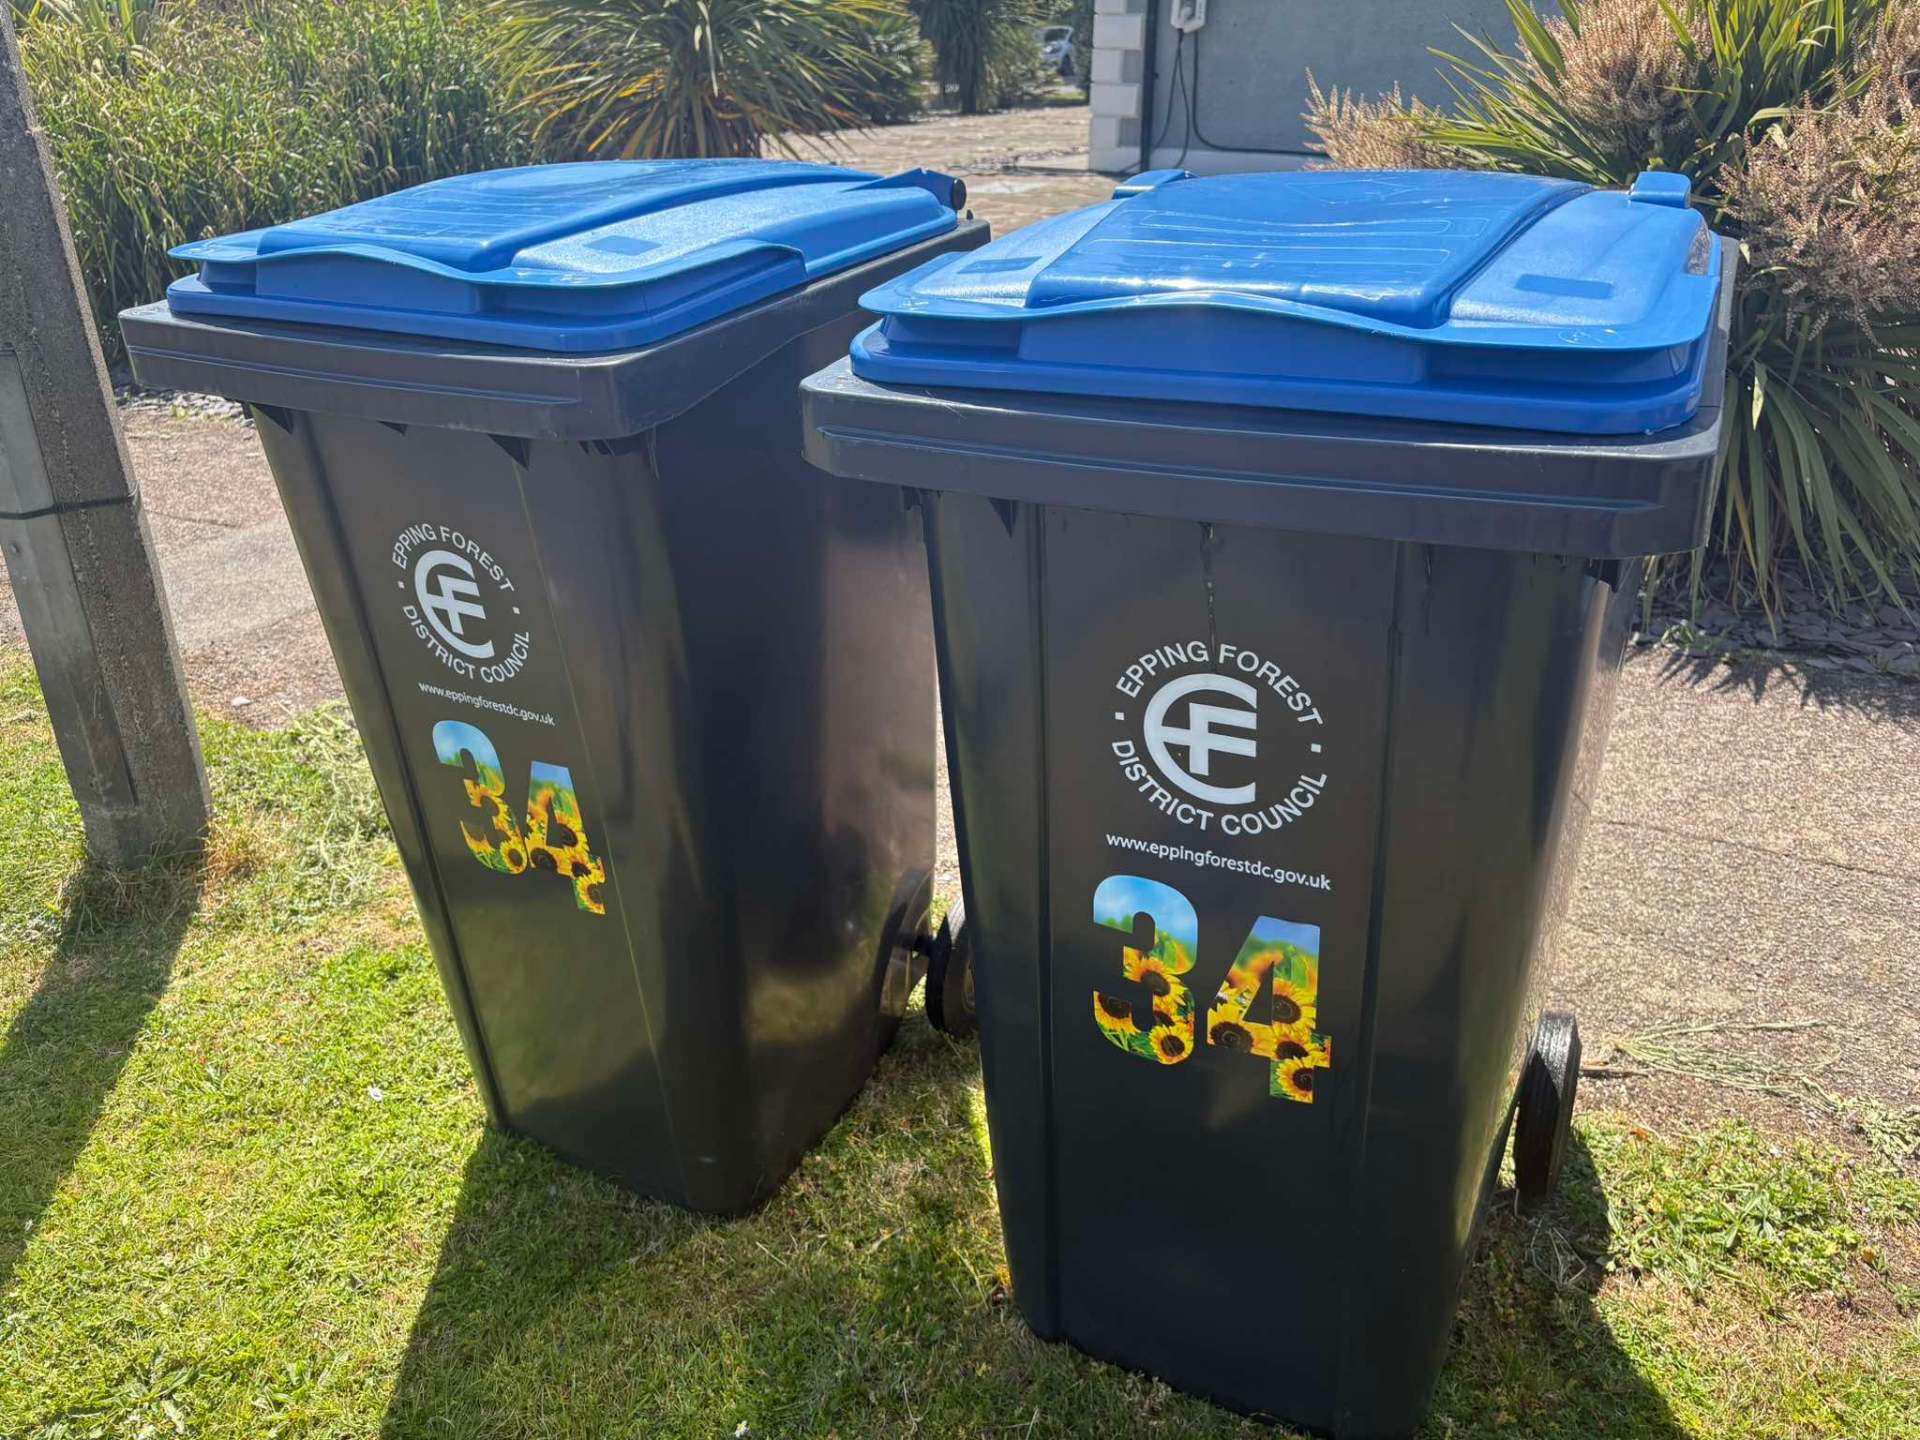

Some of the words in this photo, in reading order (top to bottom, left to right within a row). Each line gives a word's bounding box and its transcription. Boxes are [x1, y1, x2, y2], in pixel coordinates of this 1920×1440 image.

[392, 523, 437, 570] EPPING
[439, 525, 515, 592] FOREST
[402, 604, 476, 680] DISTRICT
[480, 631, 530, 684] COUNCIL
[1115, 640, 1210, 698] EPPING
[1218, 643, 1324, 726] FOREST
[418, 682, 556, 727] www.eppingforestdc.gov.uk
[432, 719, 608, 917] 34
[1111, 740, 1215, 831] DISTRICT
[1220, 773, 1328, 836] COUNCIL
[1105, 833, 1332, 891] www.eppingforestdc.gov.uk
[1092, 873, 1332, 1104] 34
